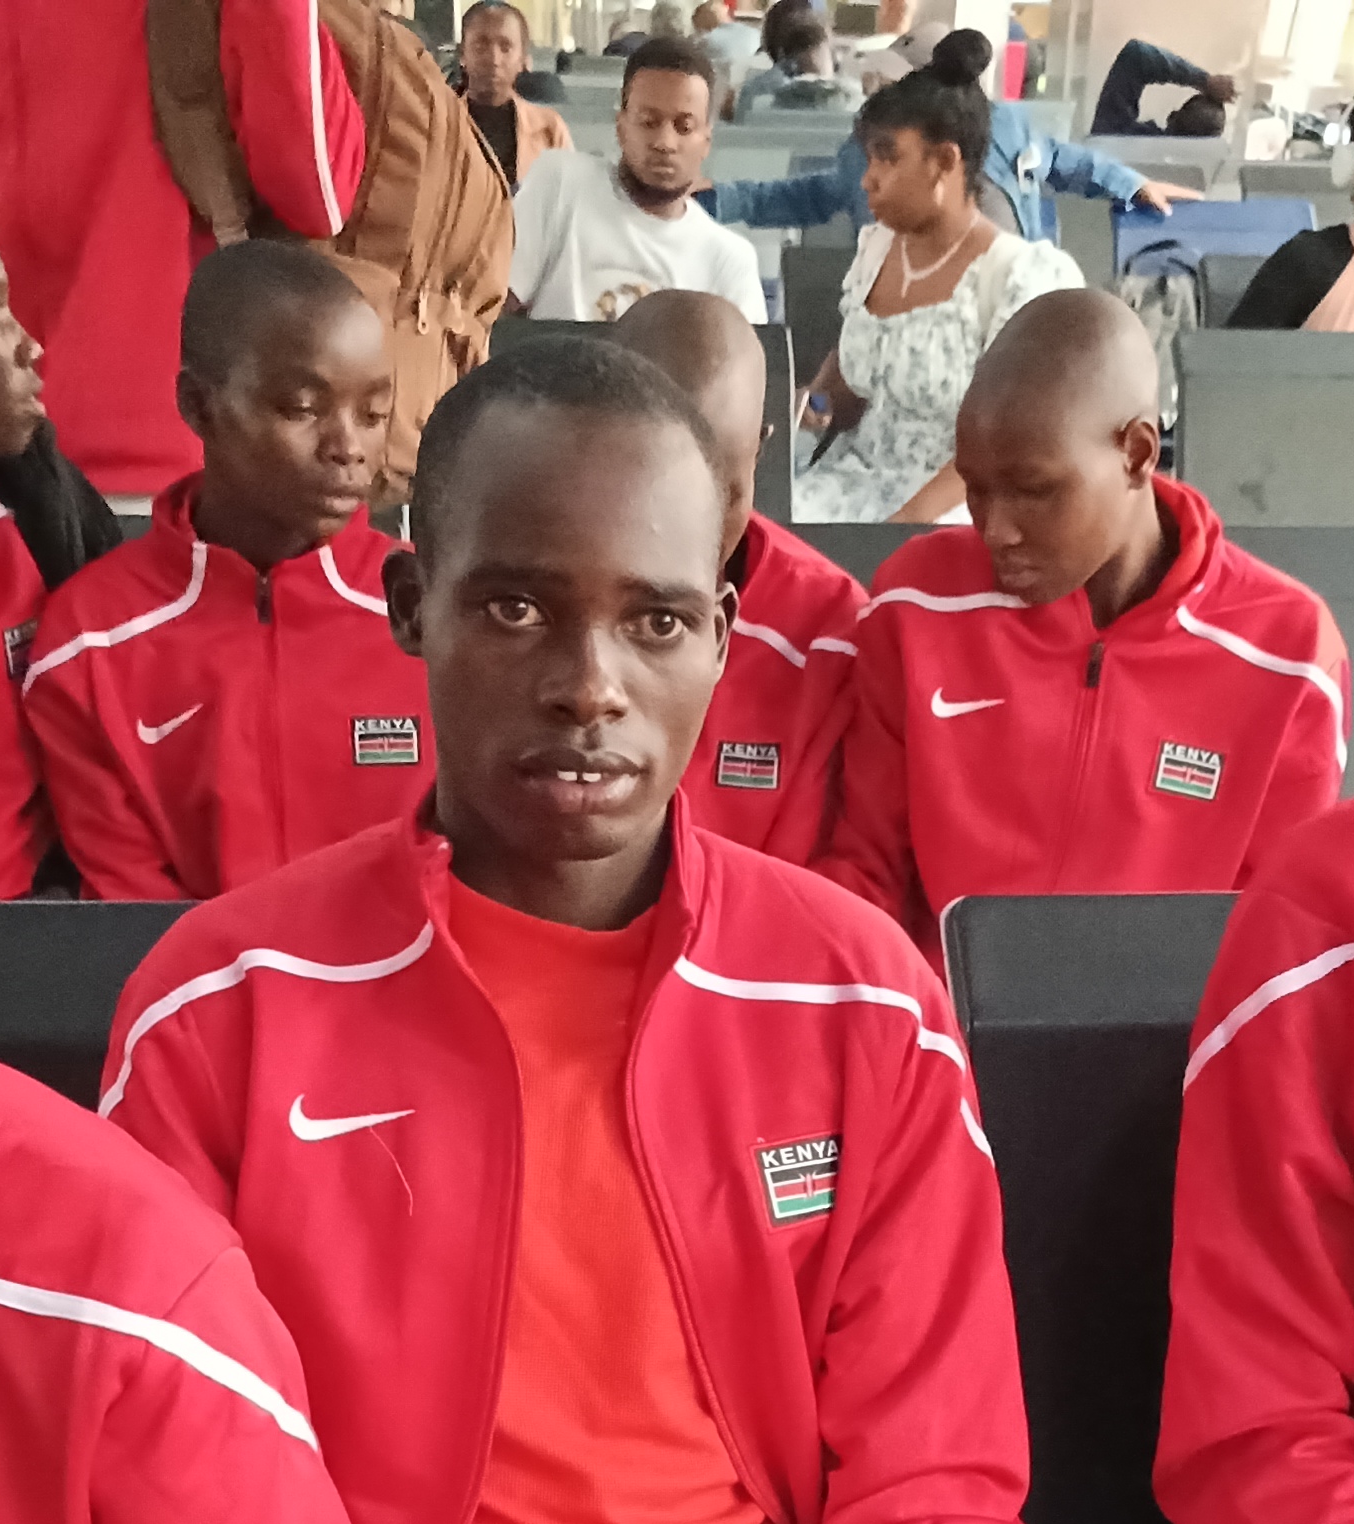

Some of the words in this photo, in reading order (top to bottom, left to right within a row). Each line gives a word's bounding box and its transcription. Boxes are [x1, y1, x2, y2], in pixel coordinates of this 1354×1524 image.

[354, 718, 416, 731] KENYA
[722, 743, 777, 757] KENYA
[1163, 742, 1220, 767] KENYA
[761, 1139, 839, 1168] KENYA
